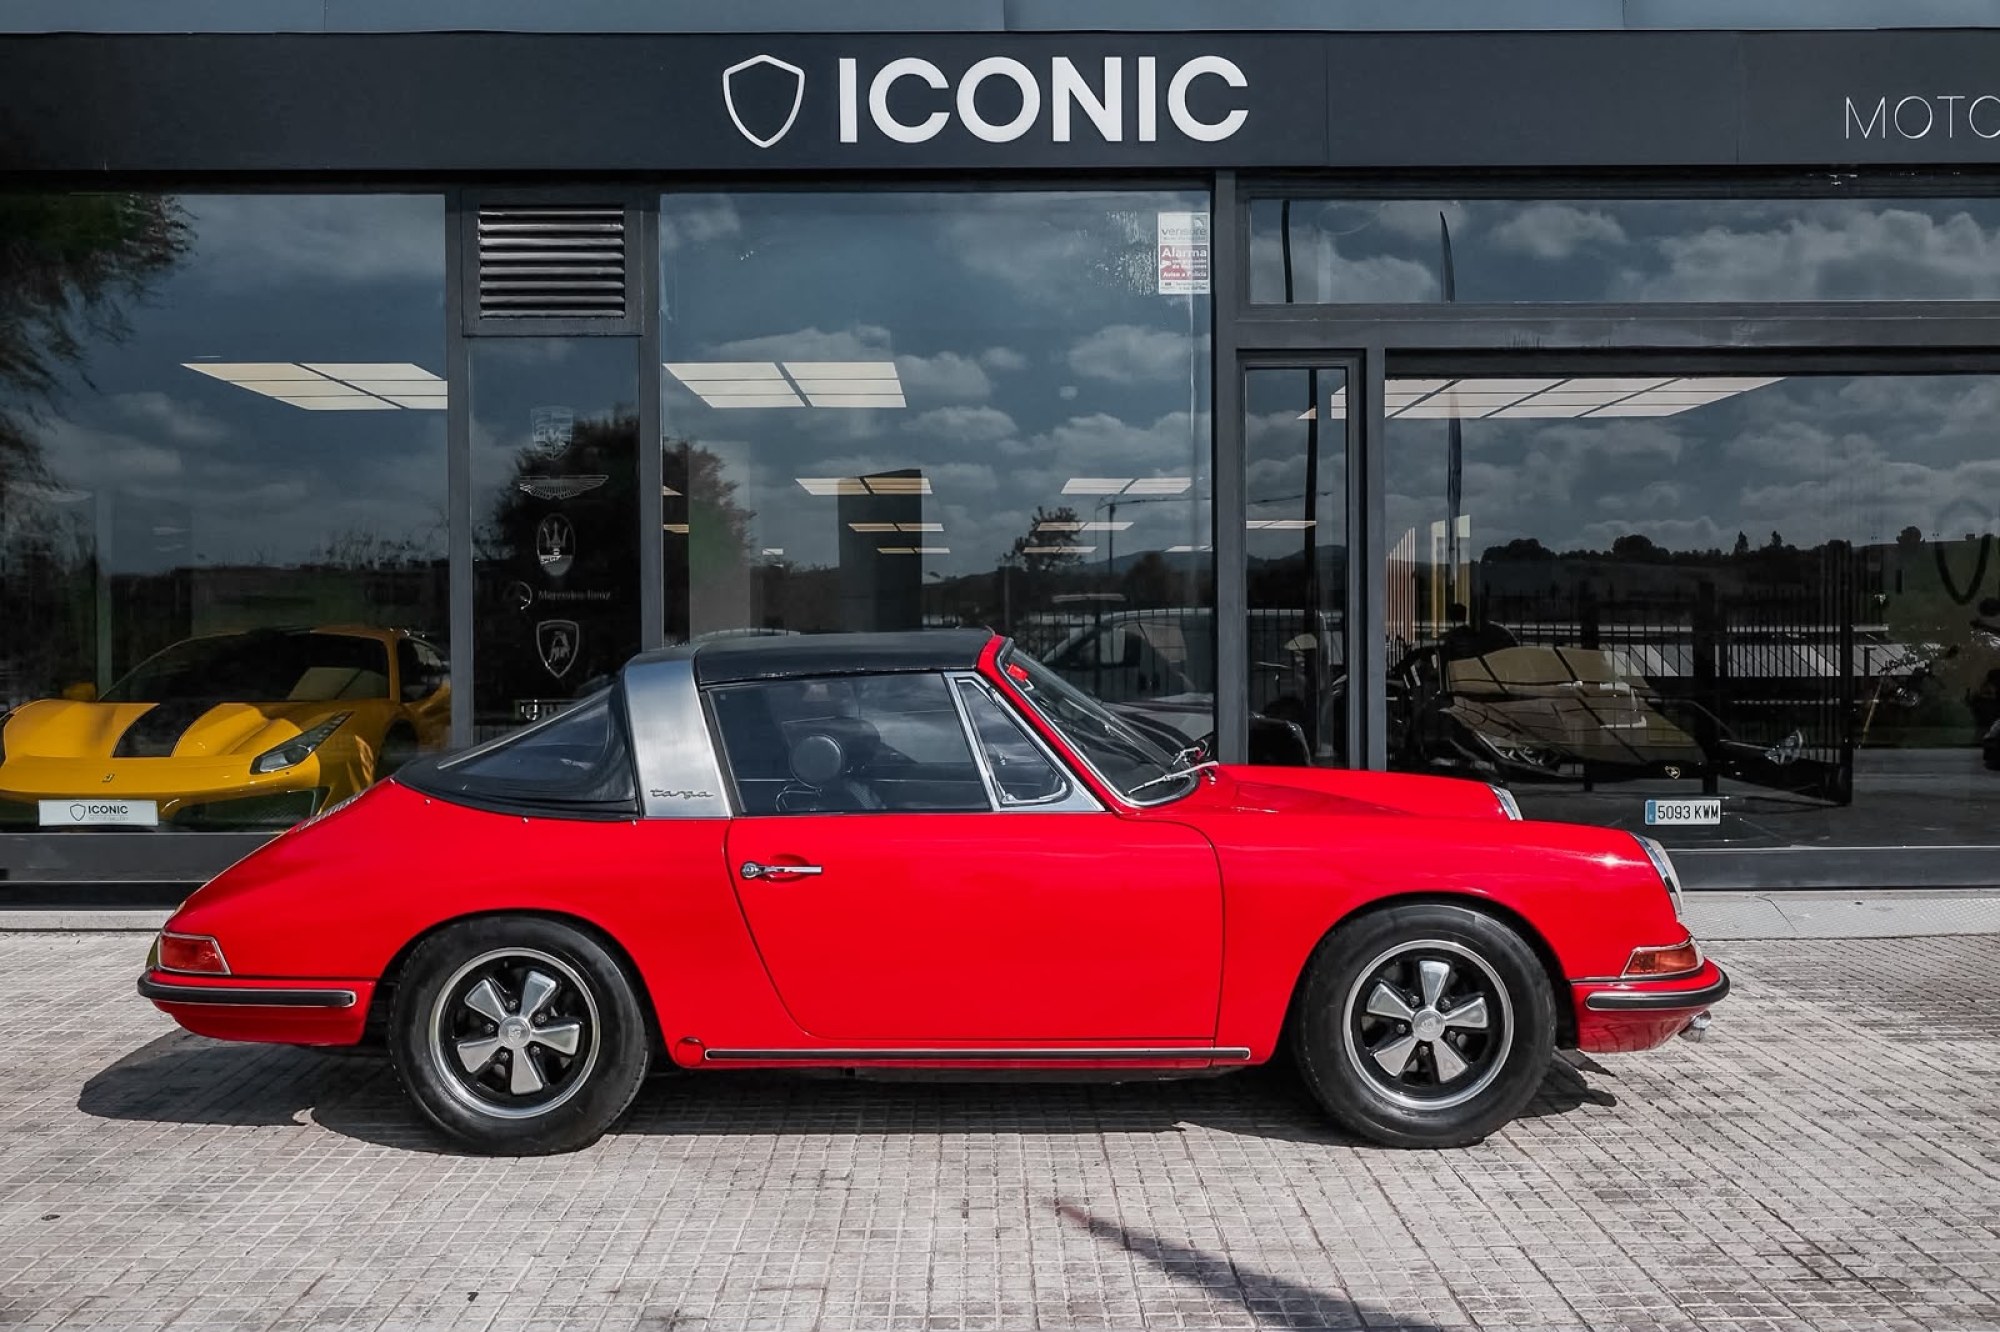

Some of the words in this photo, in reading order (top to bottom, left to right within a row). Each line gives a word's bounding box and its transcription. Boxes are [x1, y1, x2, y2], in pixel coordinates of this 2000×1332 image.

[838, 55, 1250, 144] ICONIC
[1844, 95, 2000, 140] MOTO
[1161, 247, 1207, 257] Alarma
[88, 805, 129, 814] ICONIC
[1658, 805, 1691, 820] 5093
[1694, 805, 1719, 820] KWM
